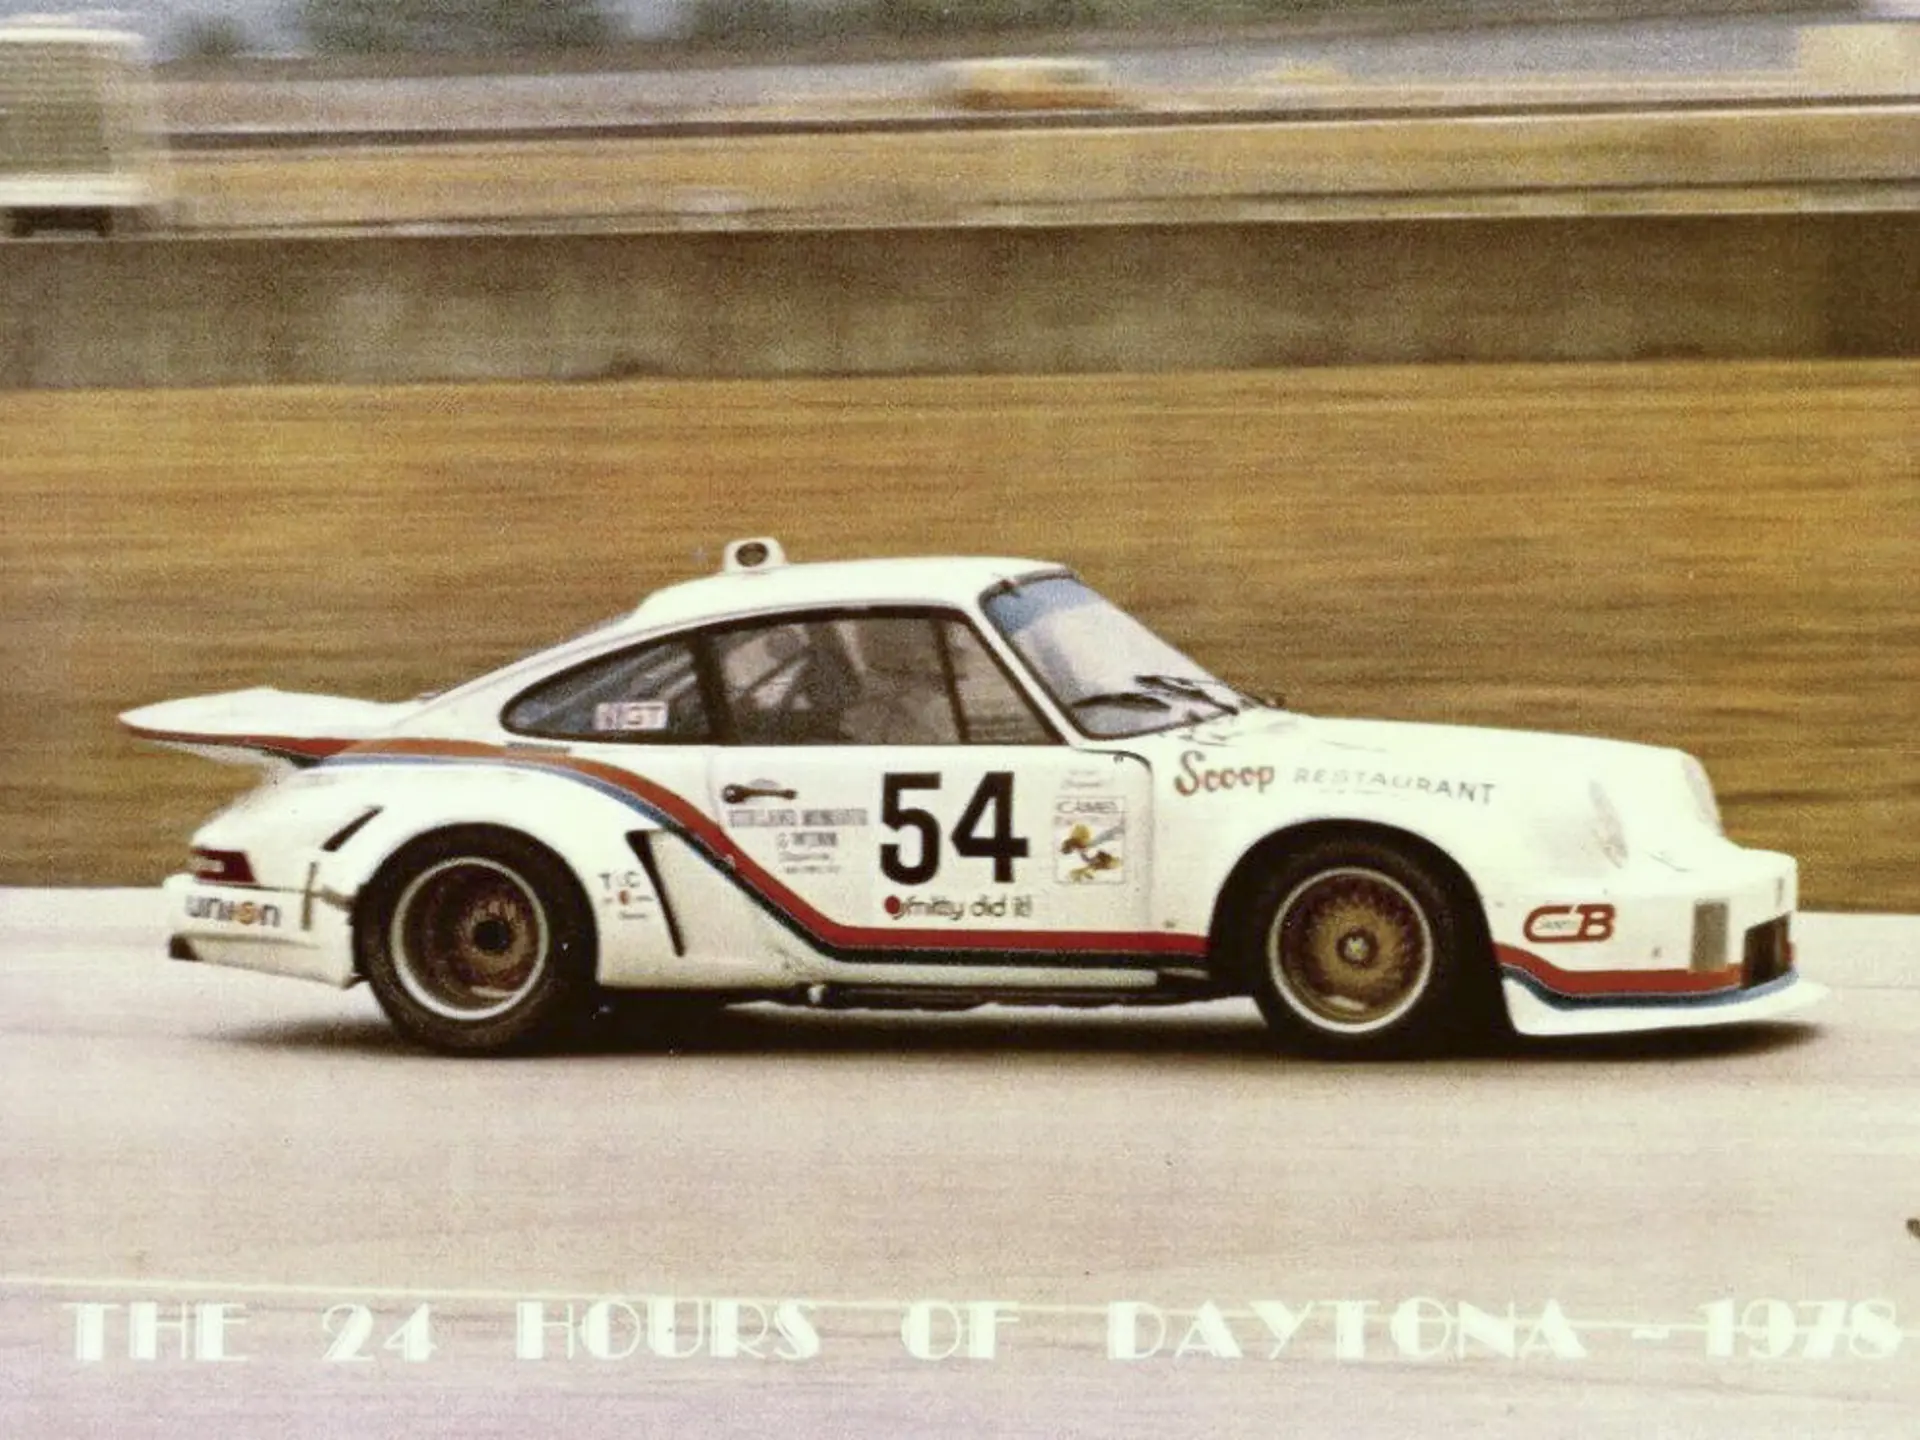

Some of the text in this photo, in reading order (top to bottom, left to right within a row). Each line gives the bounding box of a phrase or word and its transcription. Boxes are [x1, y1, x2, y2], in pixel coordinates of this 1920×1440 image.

[1174, 750, 1496, 804] Scoop RESTAURANT
[880, 772, 1029, 885] 54
[1523, 903, 1616, 943] CB
